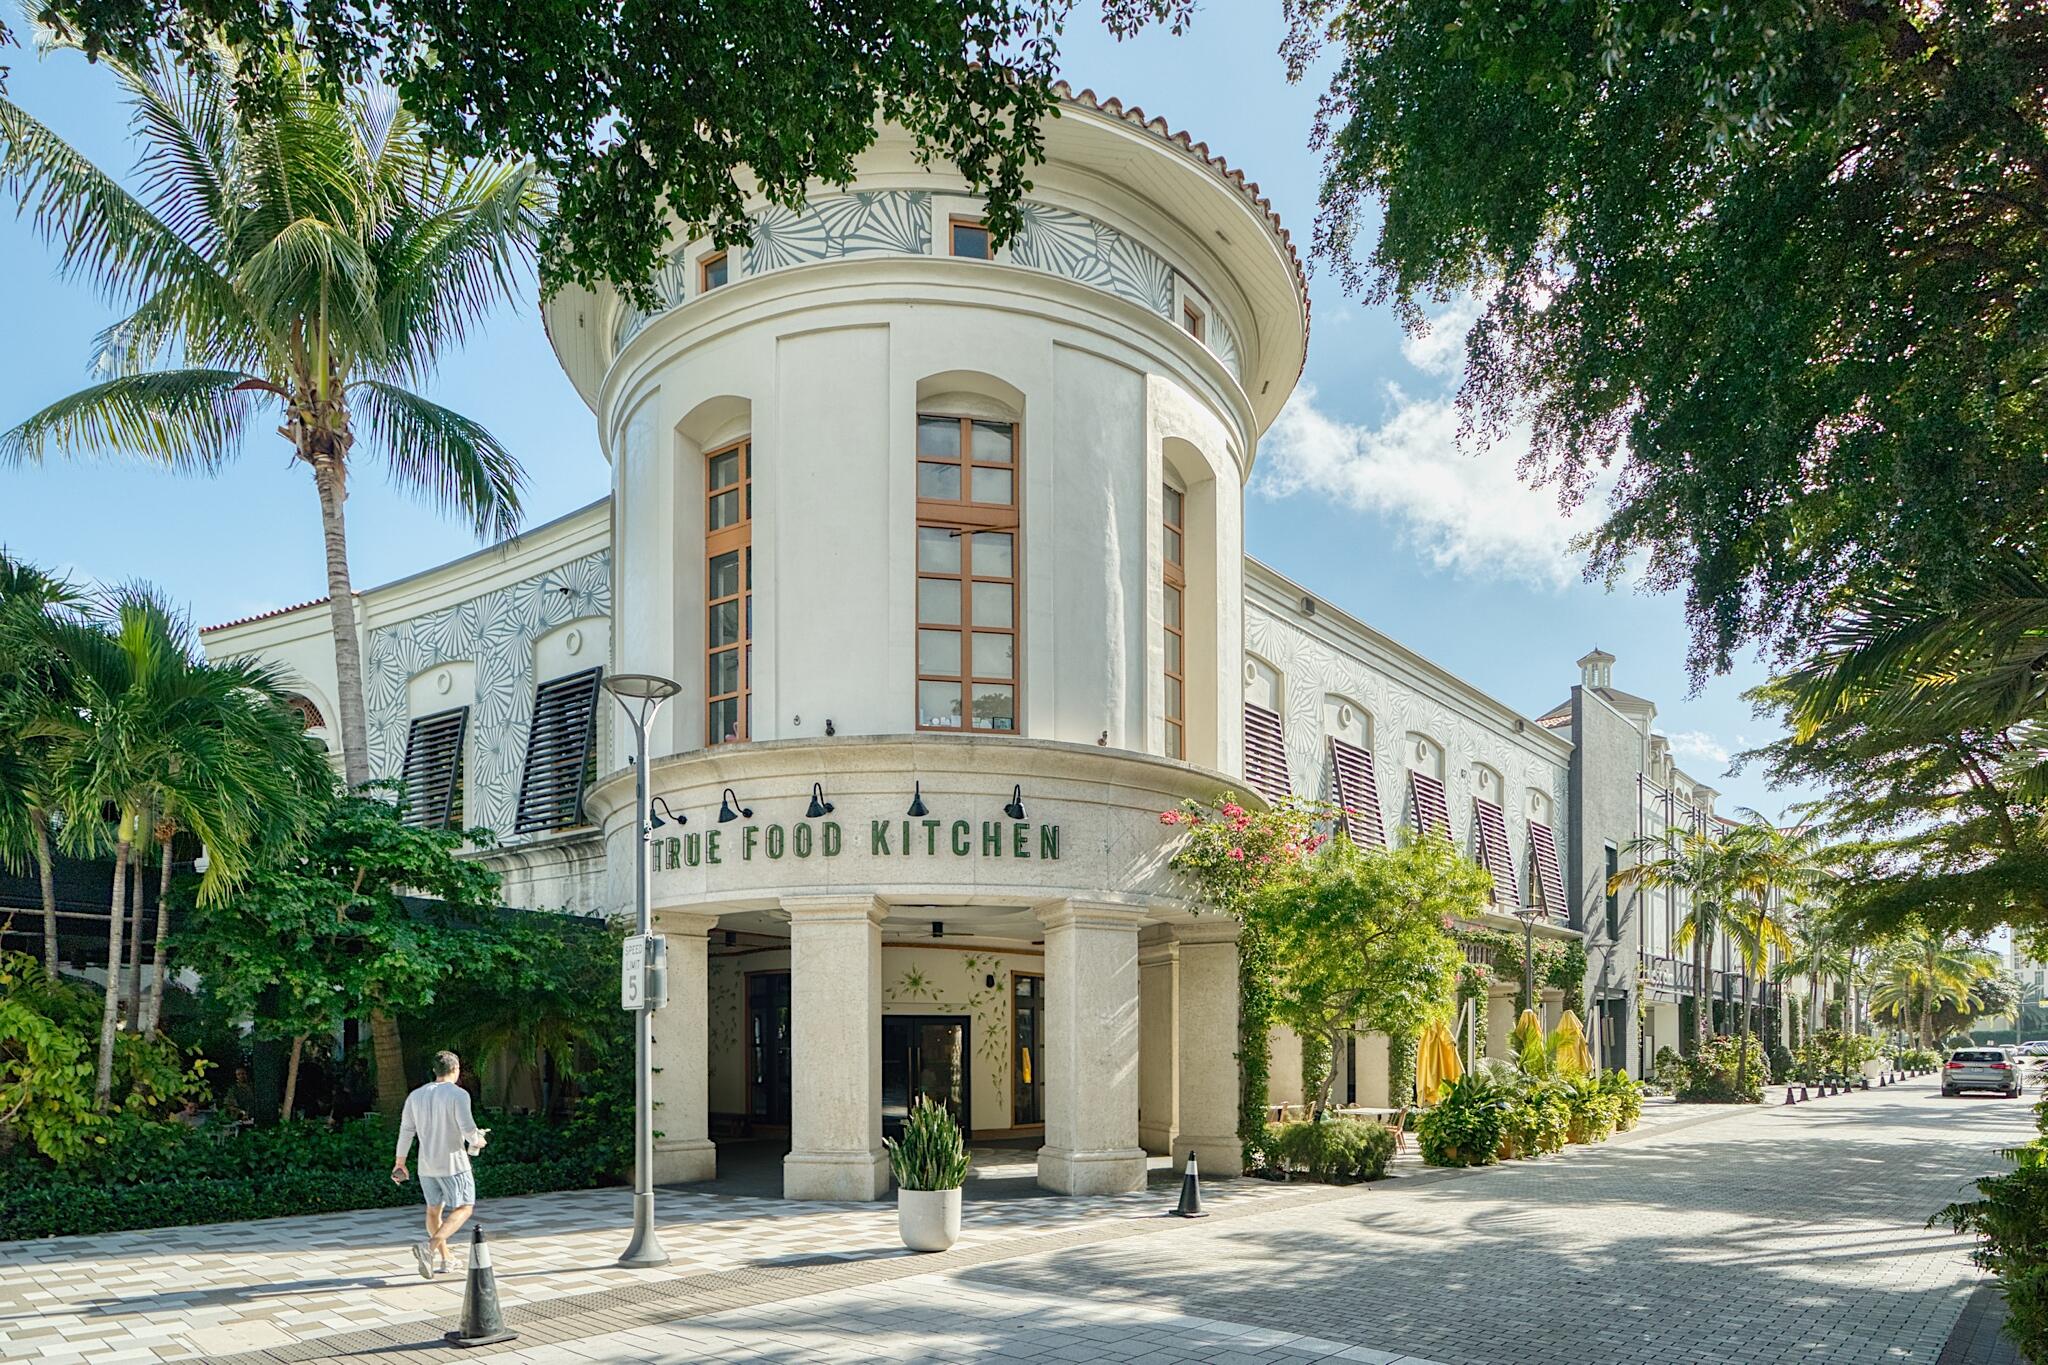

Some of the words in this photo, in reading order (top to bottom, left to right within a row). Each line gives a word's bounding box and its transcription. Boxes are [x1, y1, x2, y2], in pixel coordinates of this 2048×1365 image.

[650, 830, 722, 872] TRUE
[742, 821, 842, 861] FOOD
[871, 820, 1060, 860] KITCHEN
[625, 944, 643, 956] SPEED
[625, 959, 640, 971] LIMIT
[628, 975, 638, 1001] 5
